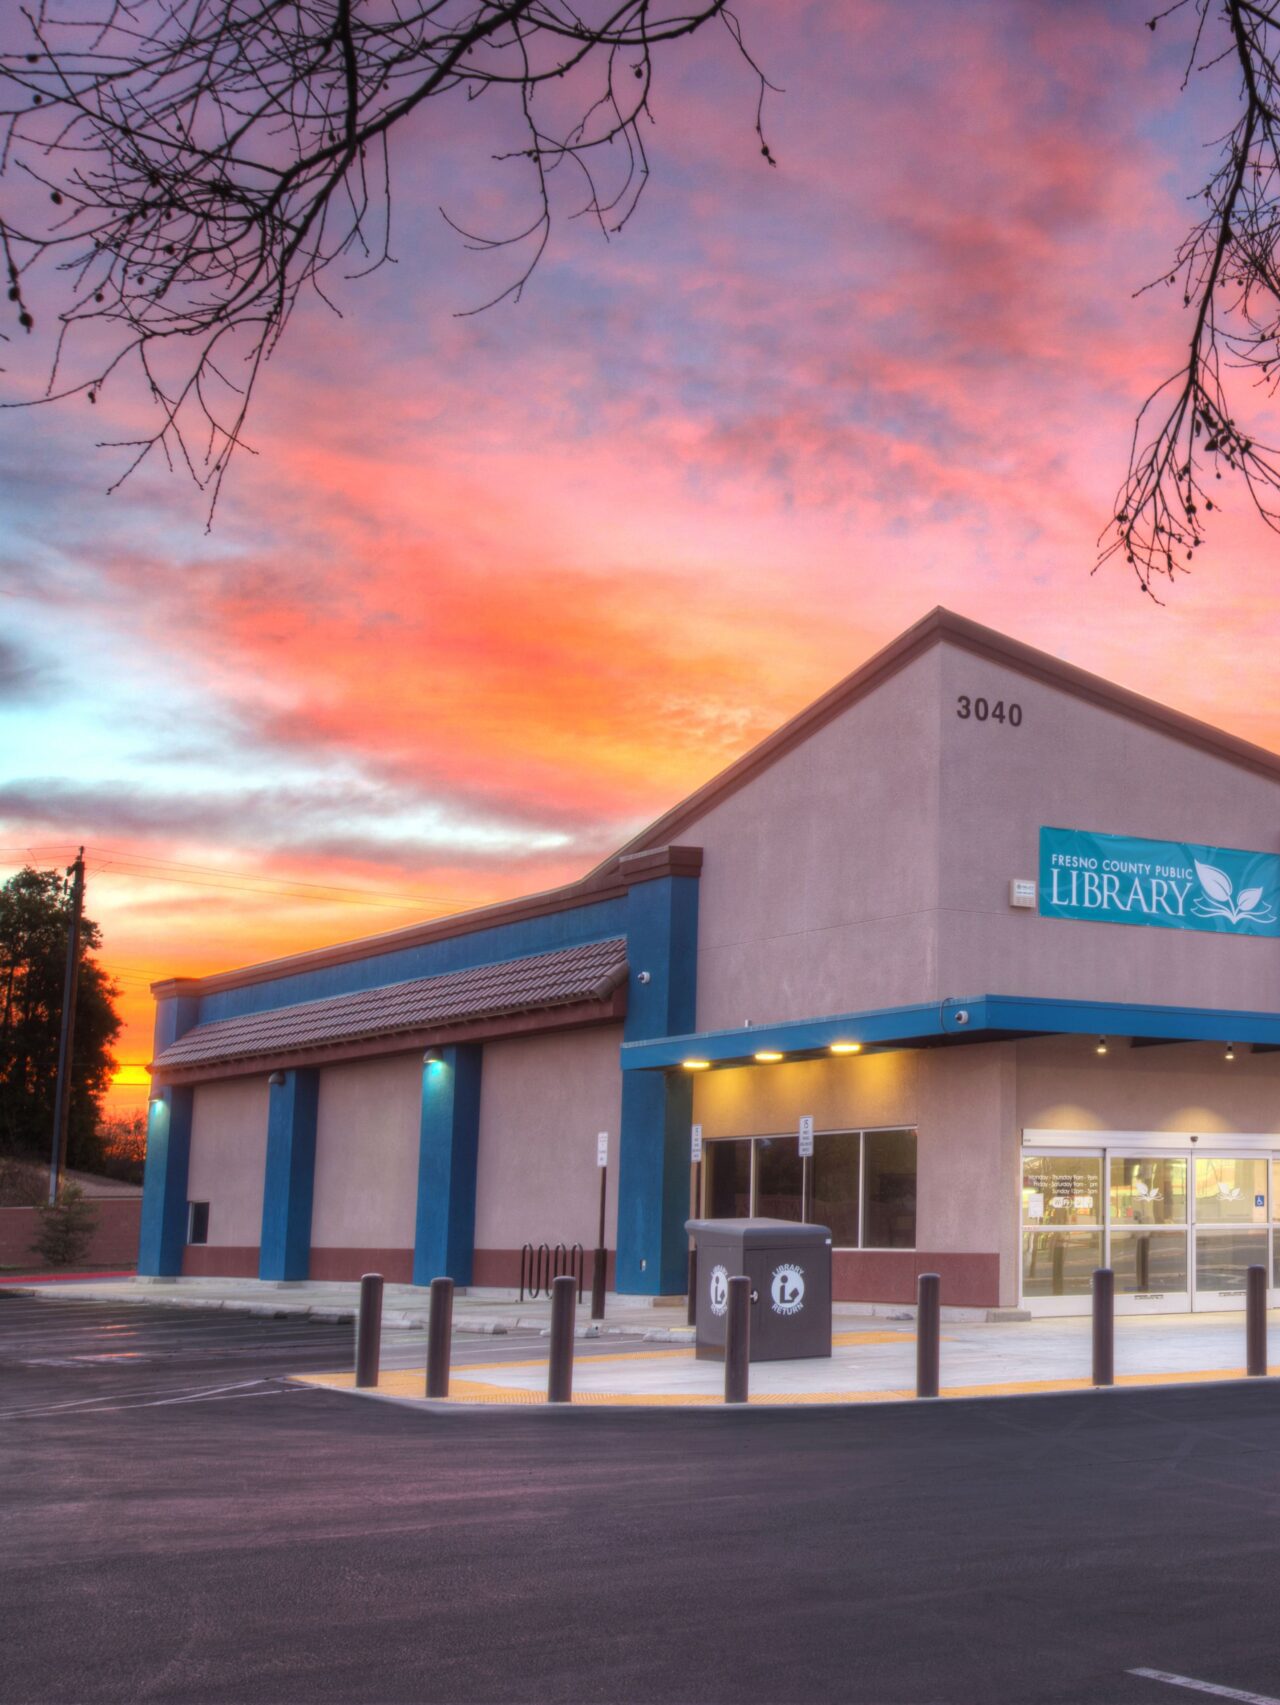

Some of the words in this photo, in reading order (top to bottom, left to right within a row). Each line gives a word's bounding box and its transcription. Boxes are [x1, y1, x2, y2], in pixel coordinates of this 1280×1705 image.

[957, 695, 1022, 727] 3040
[1051, 854, 1098, 870] FRESNO
[1102, 859, 1151, 875] COUNTY
[1155, 865, 1194, 880] PUBLIC
[1050, 868, 1193, 916] LIBRARY
[772, 1263, 805, 1277] LIBRARY
[771, 1301, 804, 1316] RETURN
